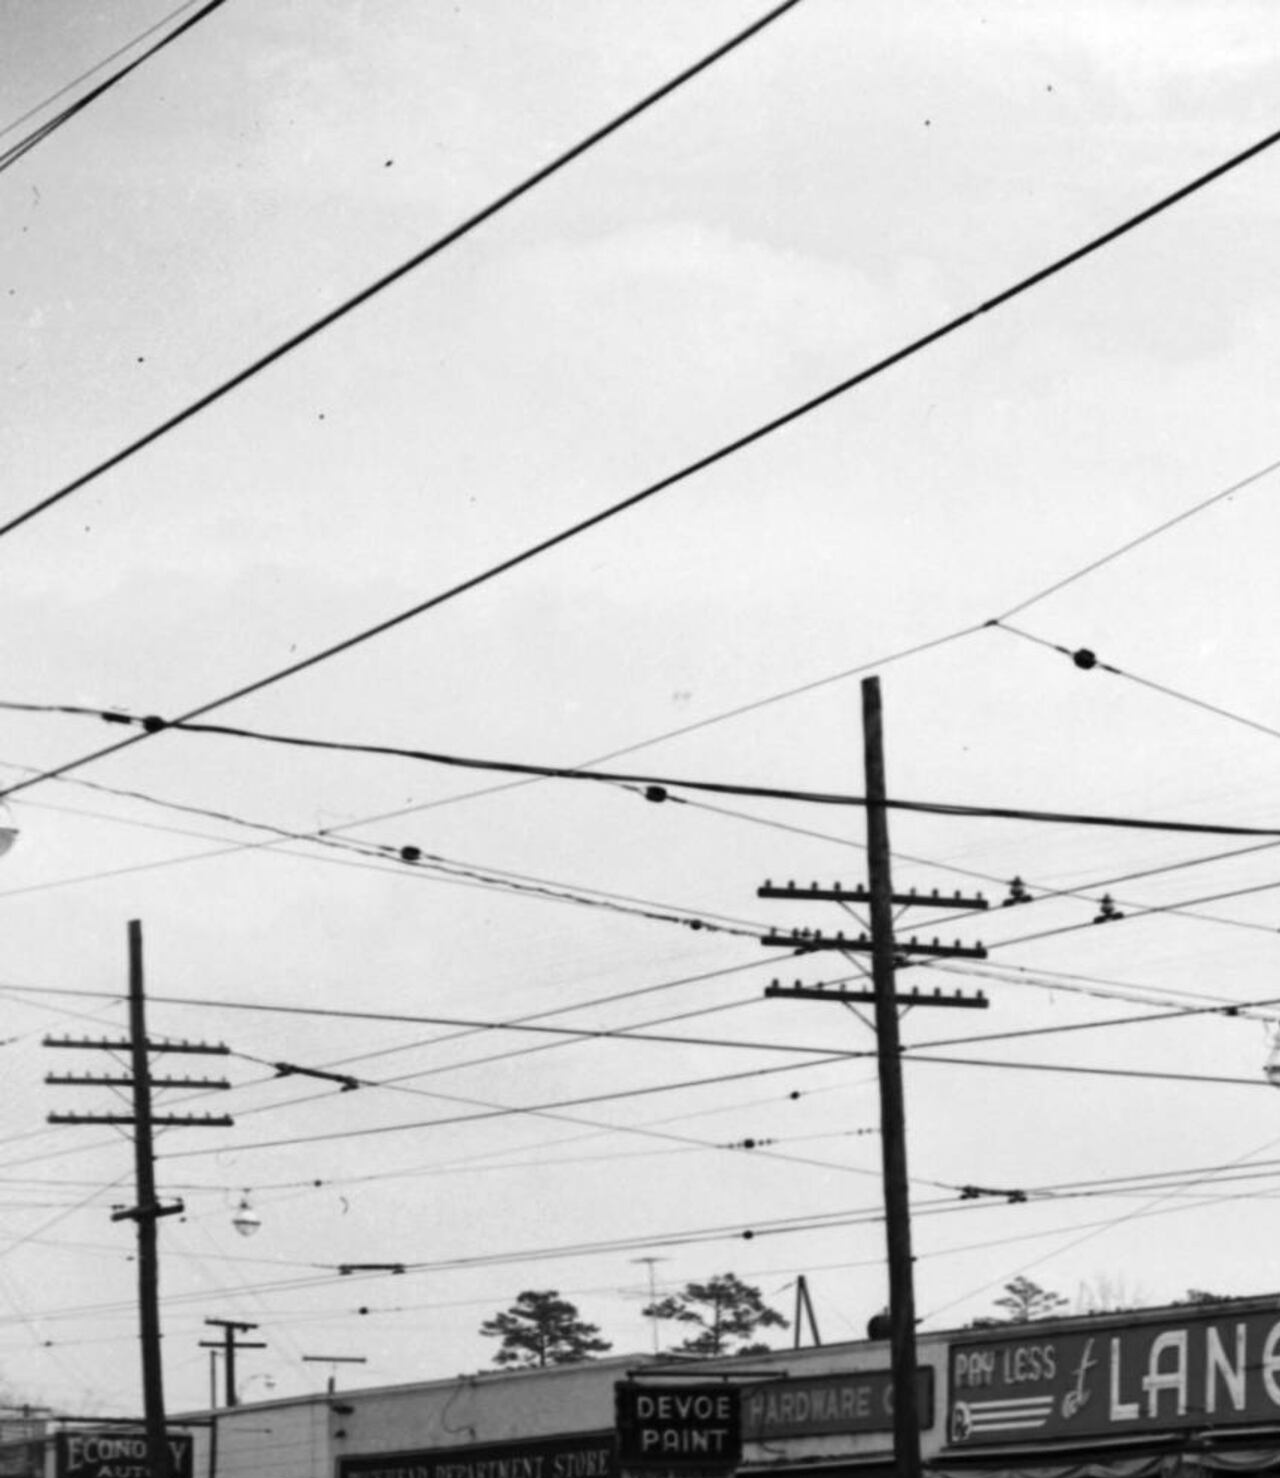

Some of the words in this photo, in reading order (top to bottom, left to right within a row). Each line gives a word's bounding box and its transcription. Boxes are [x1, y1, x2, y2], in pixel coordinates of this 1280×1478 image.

[955, 1351, 996, 1388] PAY
[1004, 1344, 1057, 1384] LESS
[637, 1395, 731, 1420] DEVOE
[750, 1385, 872, 1426] HARDWARE
[65, 1436, 187, 1475] ECONOY
[641, 1428, 729, 1452] PAINT
